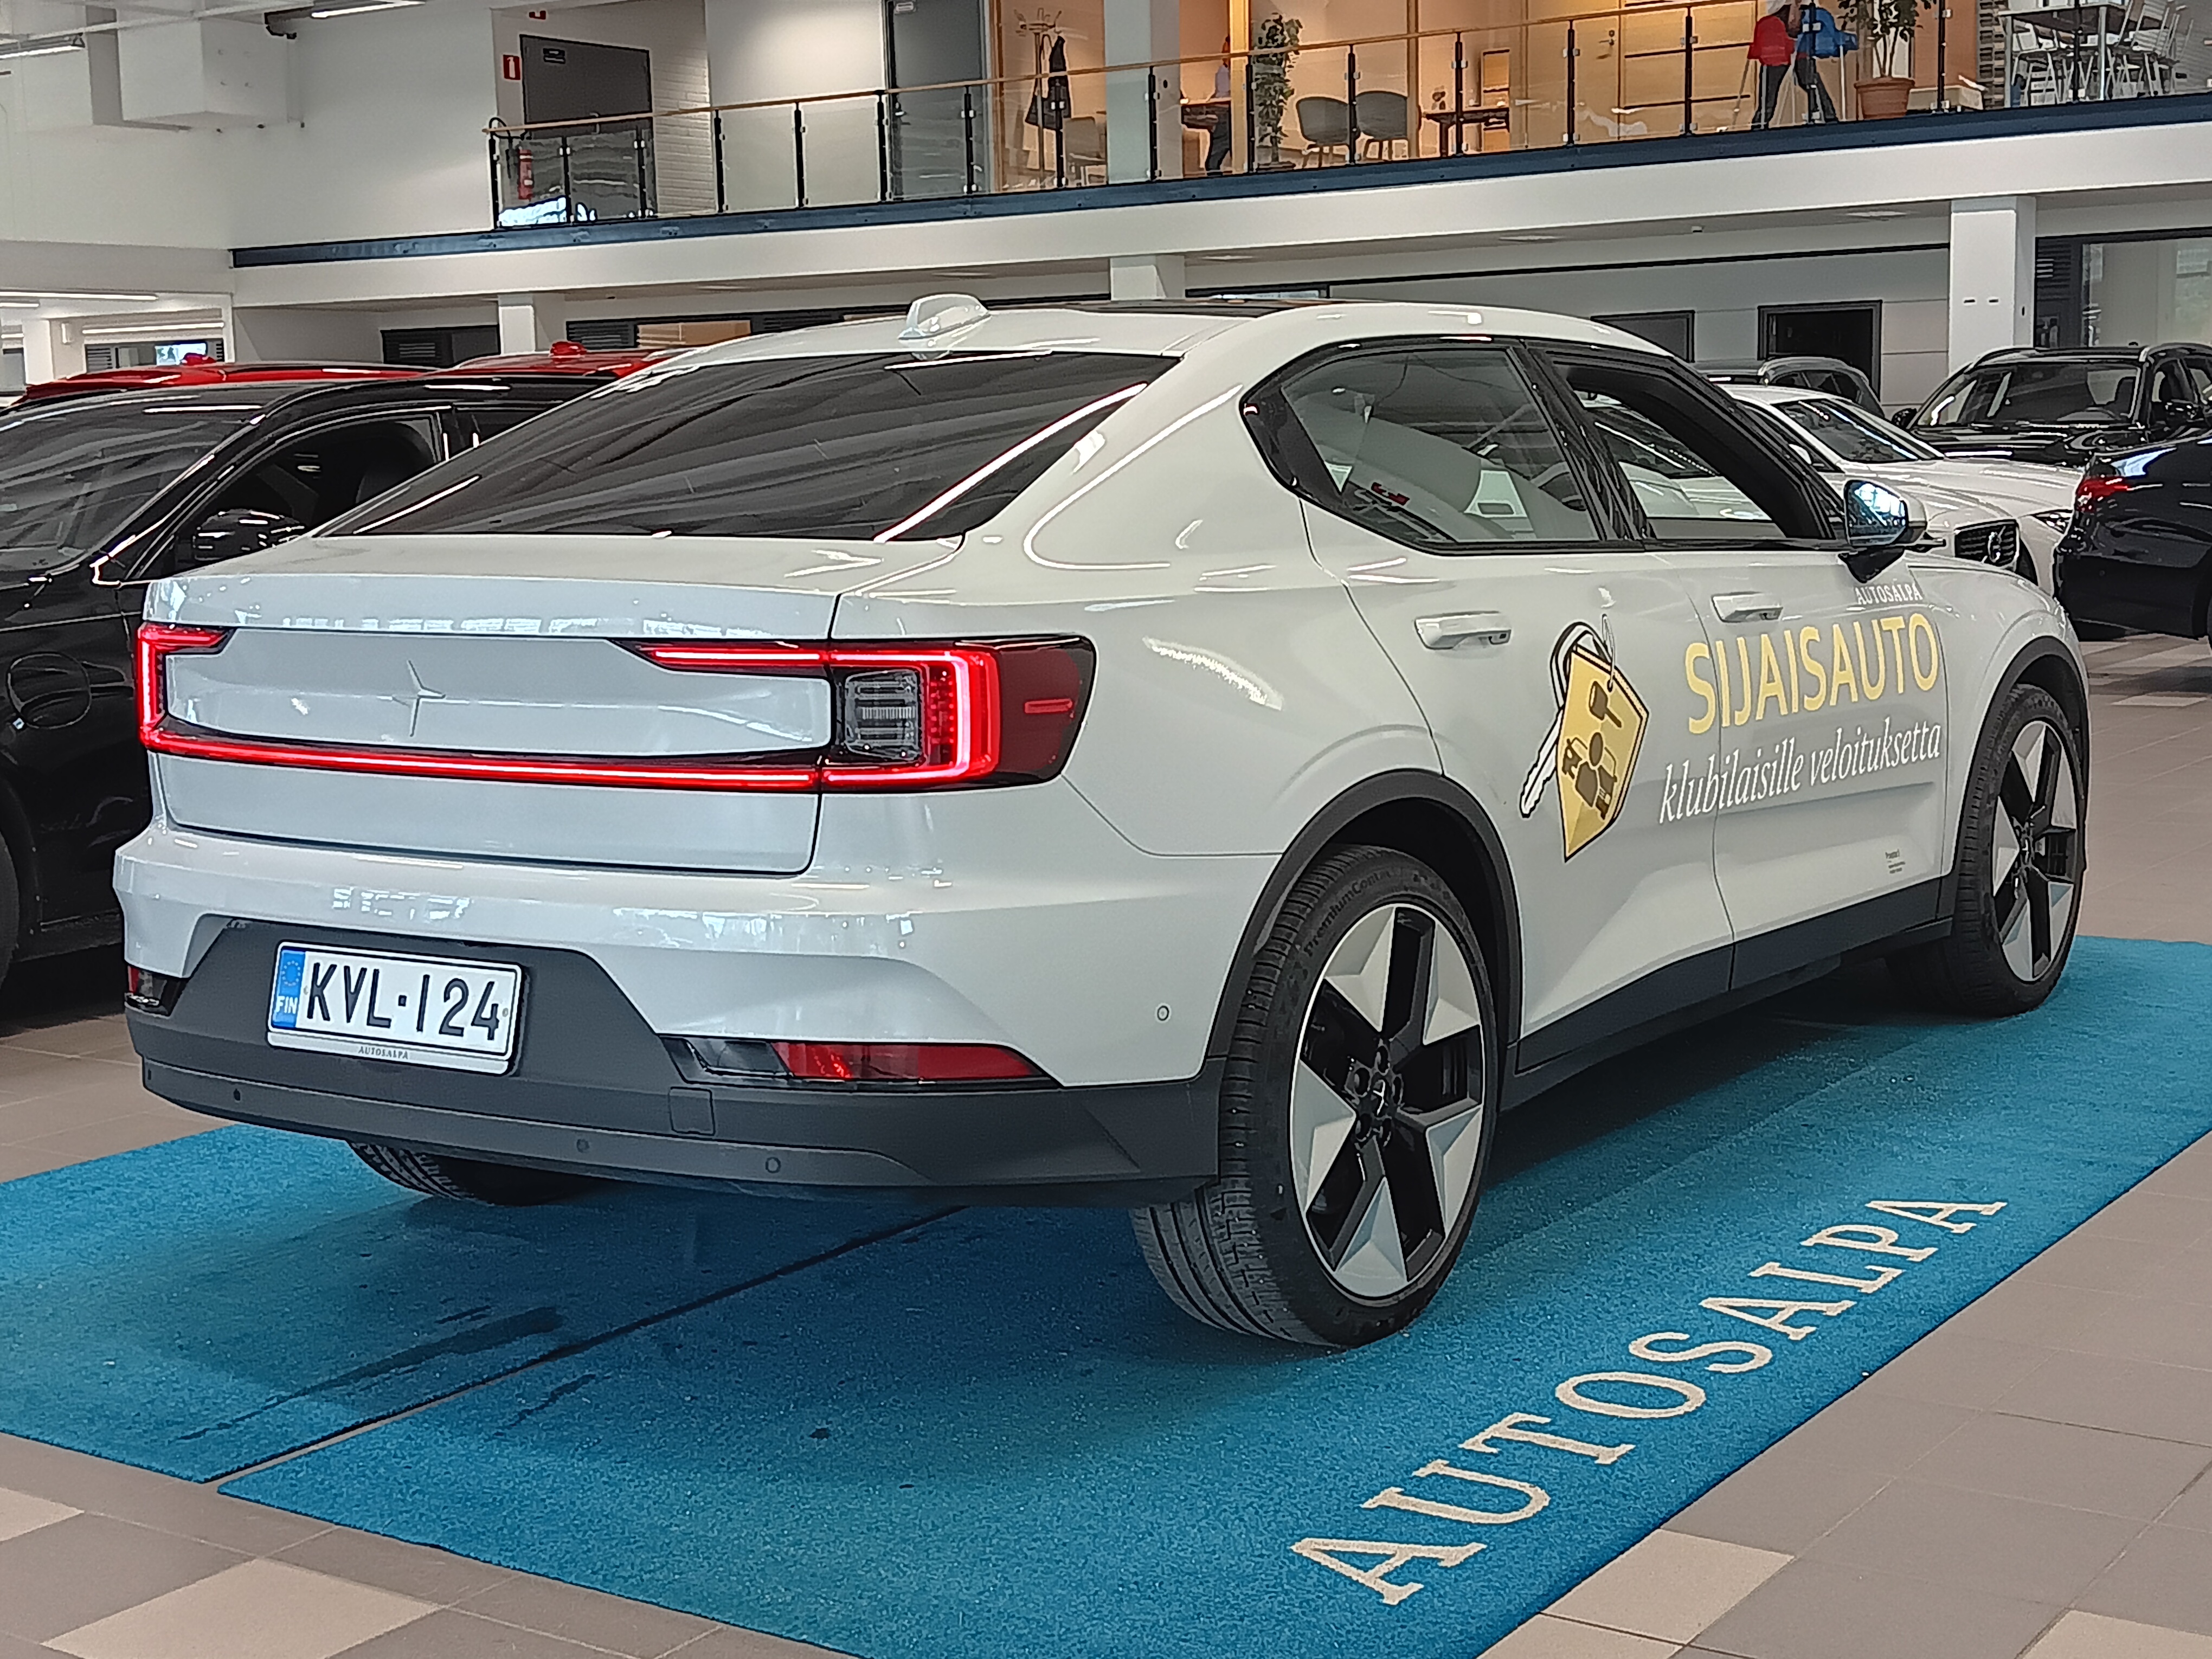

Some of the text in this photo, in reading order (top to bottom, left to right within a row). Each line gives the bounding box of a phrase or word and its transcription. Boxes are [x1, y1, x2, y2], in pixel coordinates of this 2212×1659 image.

[1855, 583, 1923, 605] AUTOSALPA
[1684, 613, 1938, 734] SIJAISAUTO
[1659, 717, 1940, 823] klubilaisille veloituksetta
[276, 995, 298, 1014] FIN
[358, 1046, 408, 1060] AUTOSALPA
[1290, 1199, 2008, 1606] AUTOSALPA
